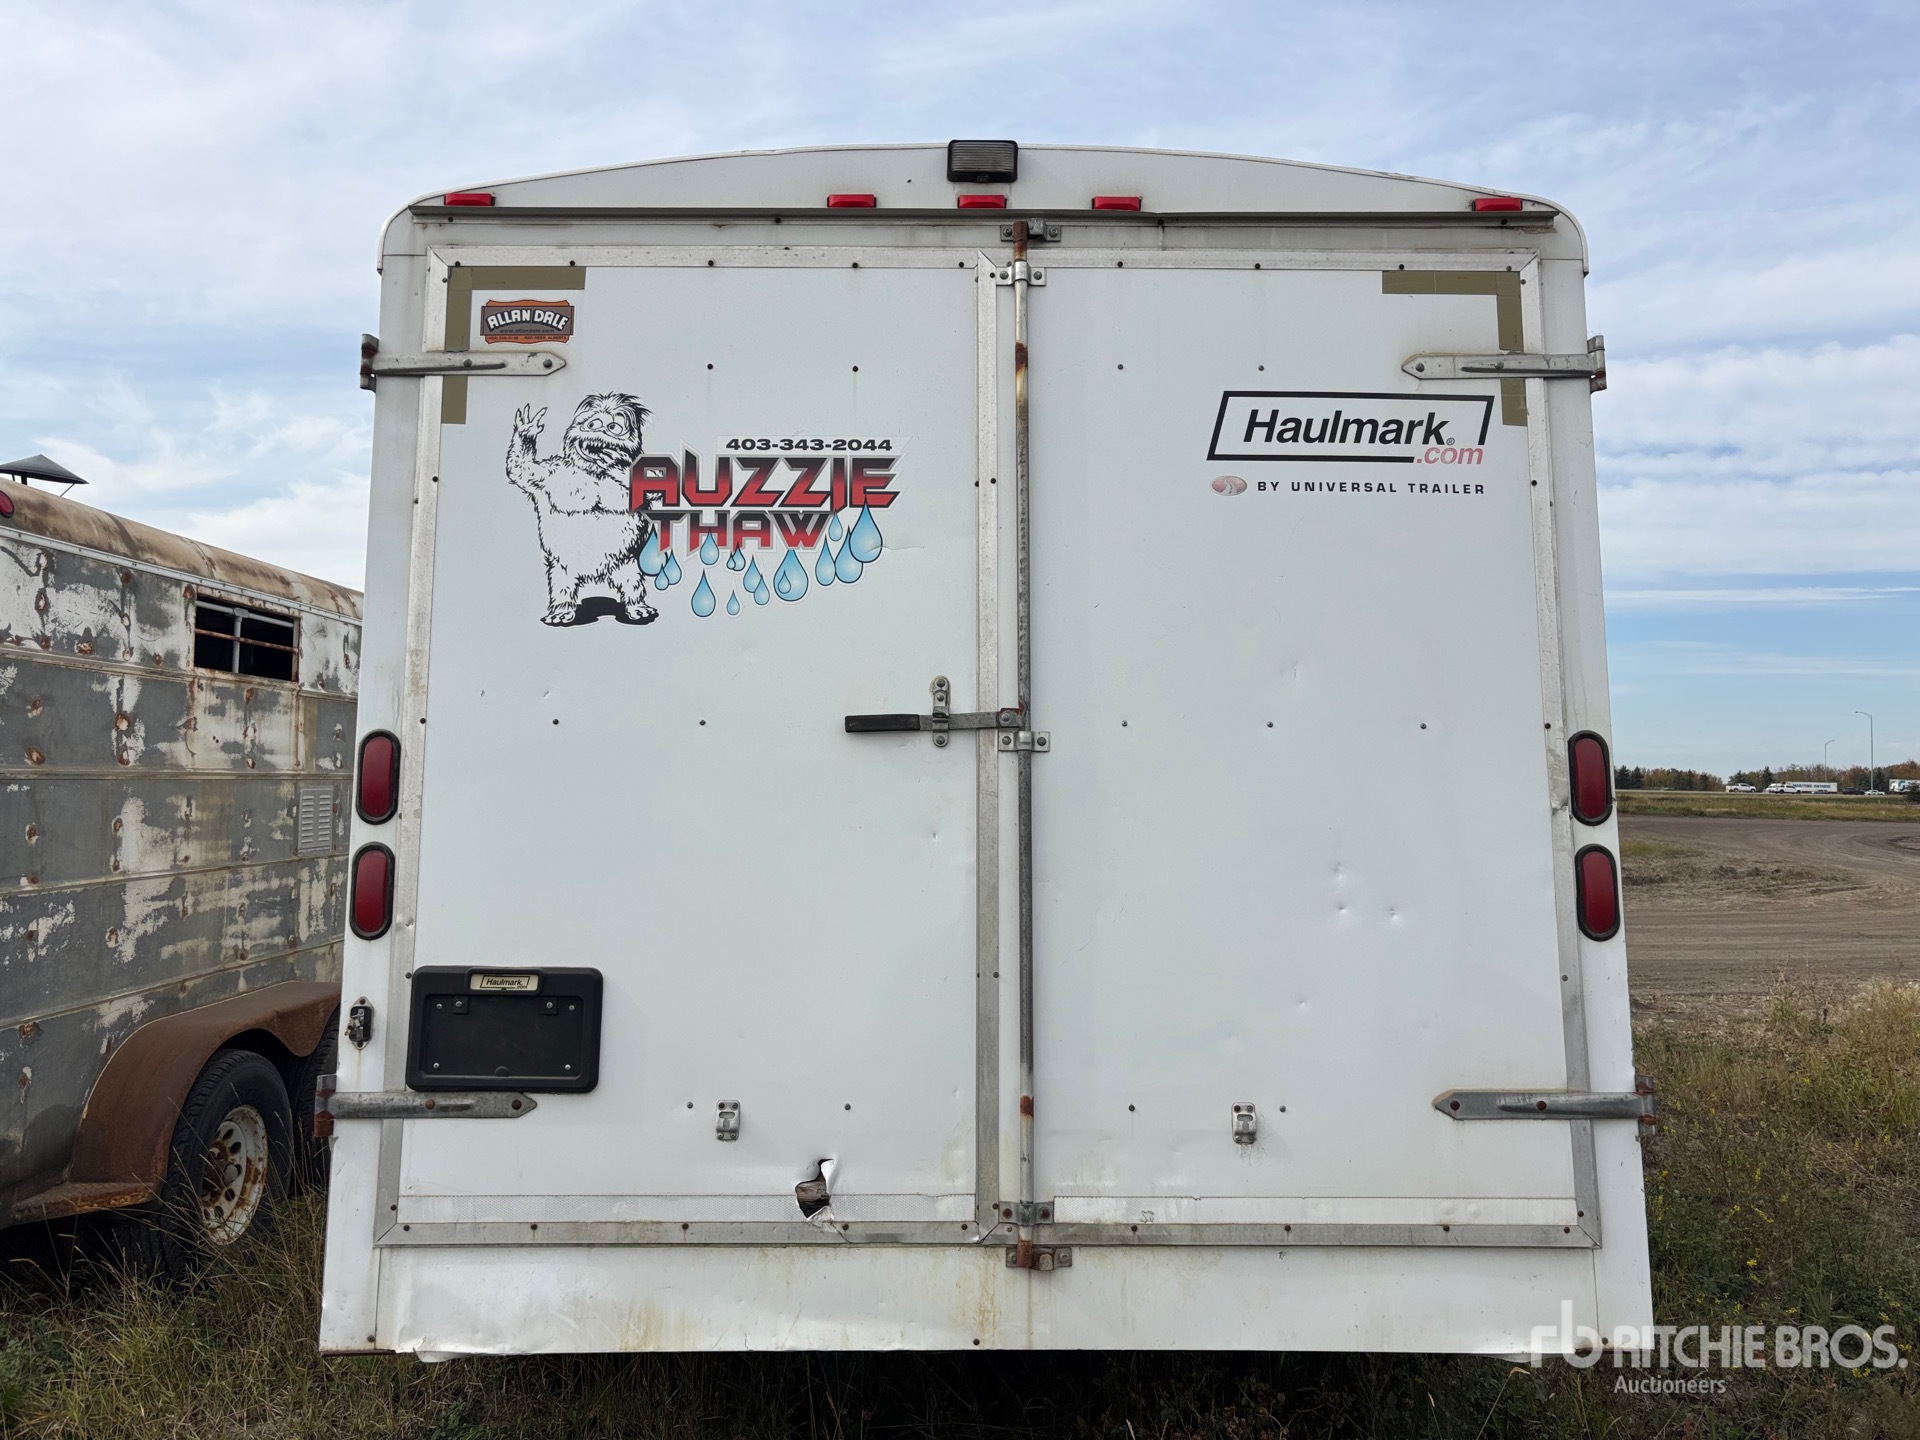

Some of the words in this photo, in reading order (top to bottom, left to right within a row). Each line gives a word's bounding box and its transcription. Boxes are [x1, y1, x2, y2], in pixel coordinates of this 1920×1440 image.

[486, 309, 531, 330] ALLAN
[533, 309, 569, 331] DALE
[725, 438, 893, 451] 403-343-2044
[1243, 409, 1450, 446] Haulmark
[1416, 447, 1484, 465] .com
[629, 450, 901, 511] AUZZIE
[1257, 481, 1280, 492] BY
[1291, 481, 1398, 493] UNIVERSAL
[1408, 483, 1485, 495] TRAILER
[645, 510, 832, 555] THAW
